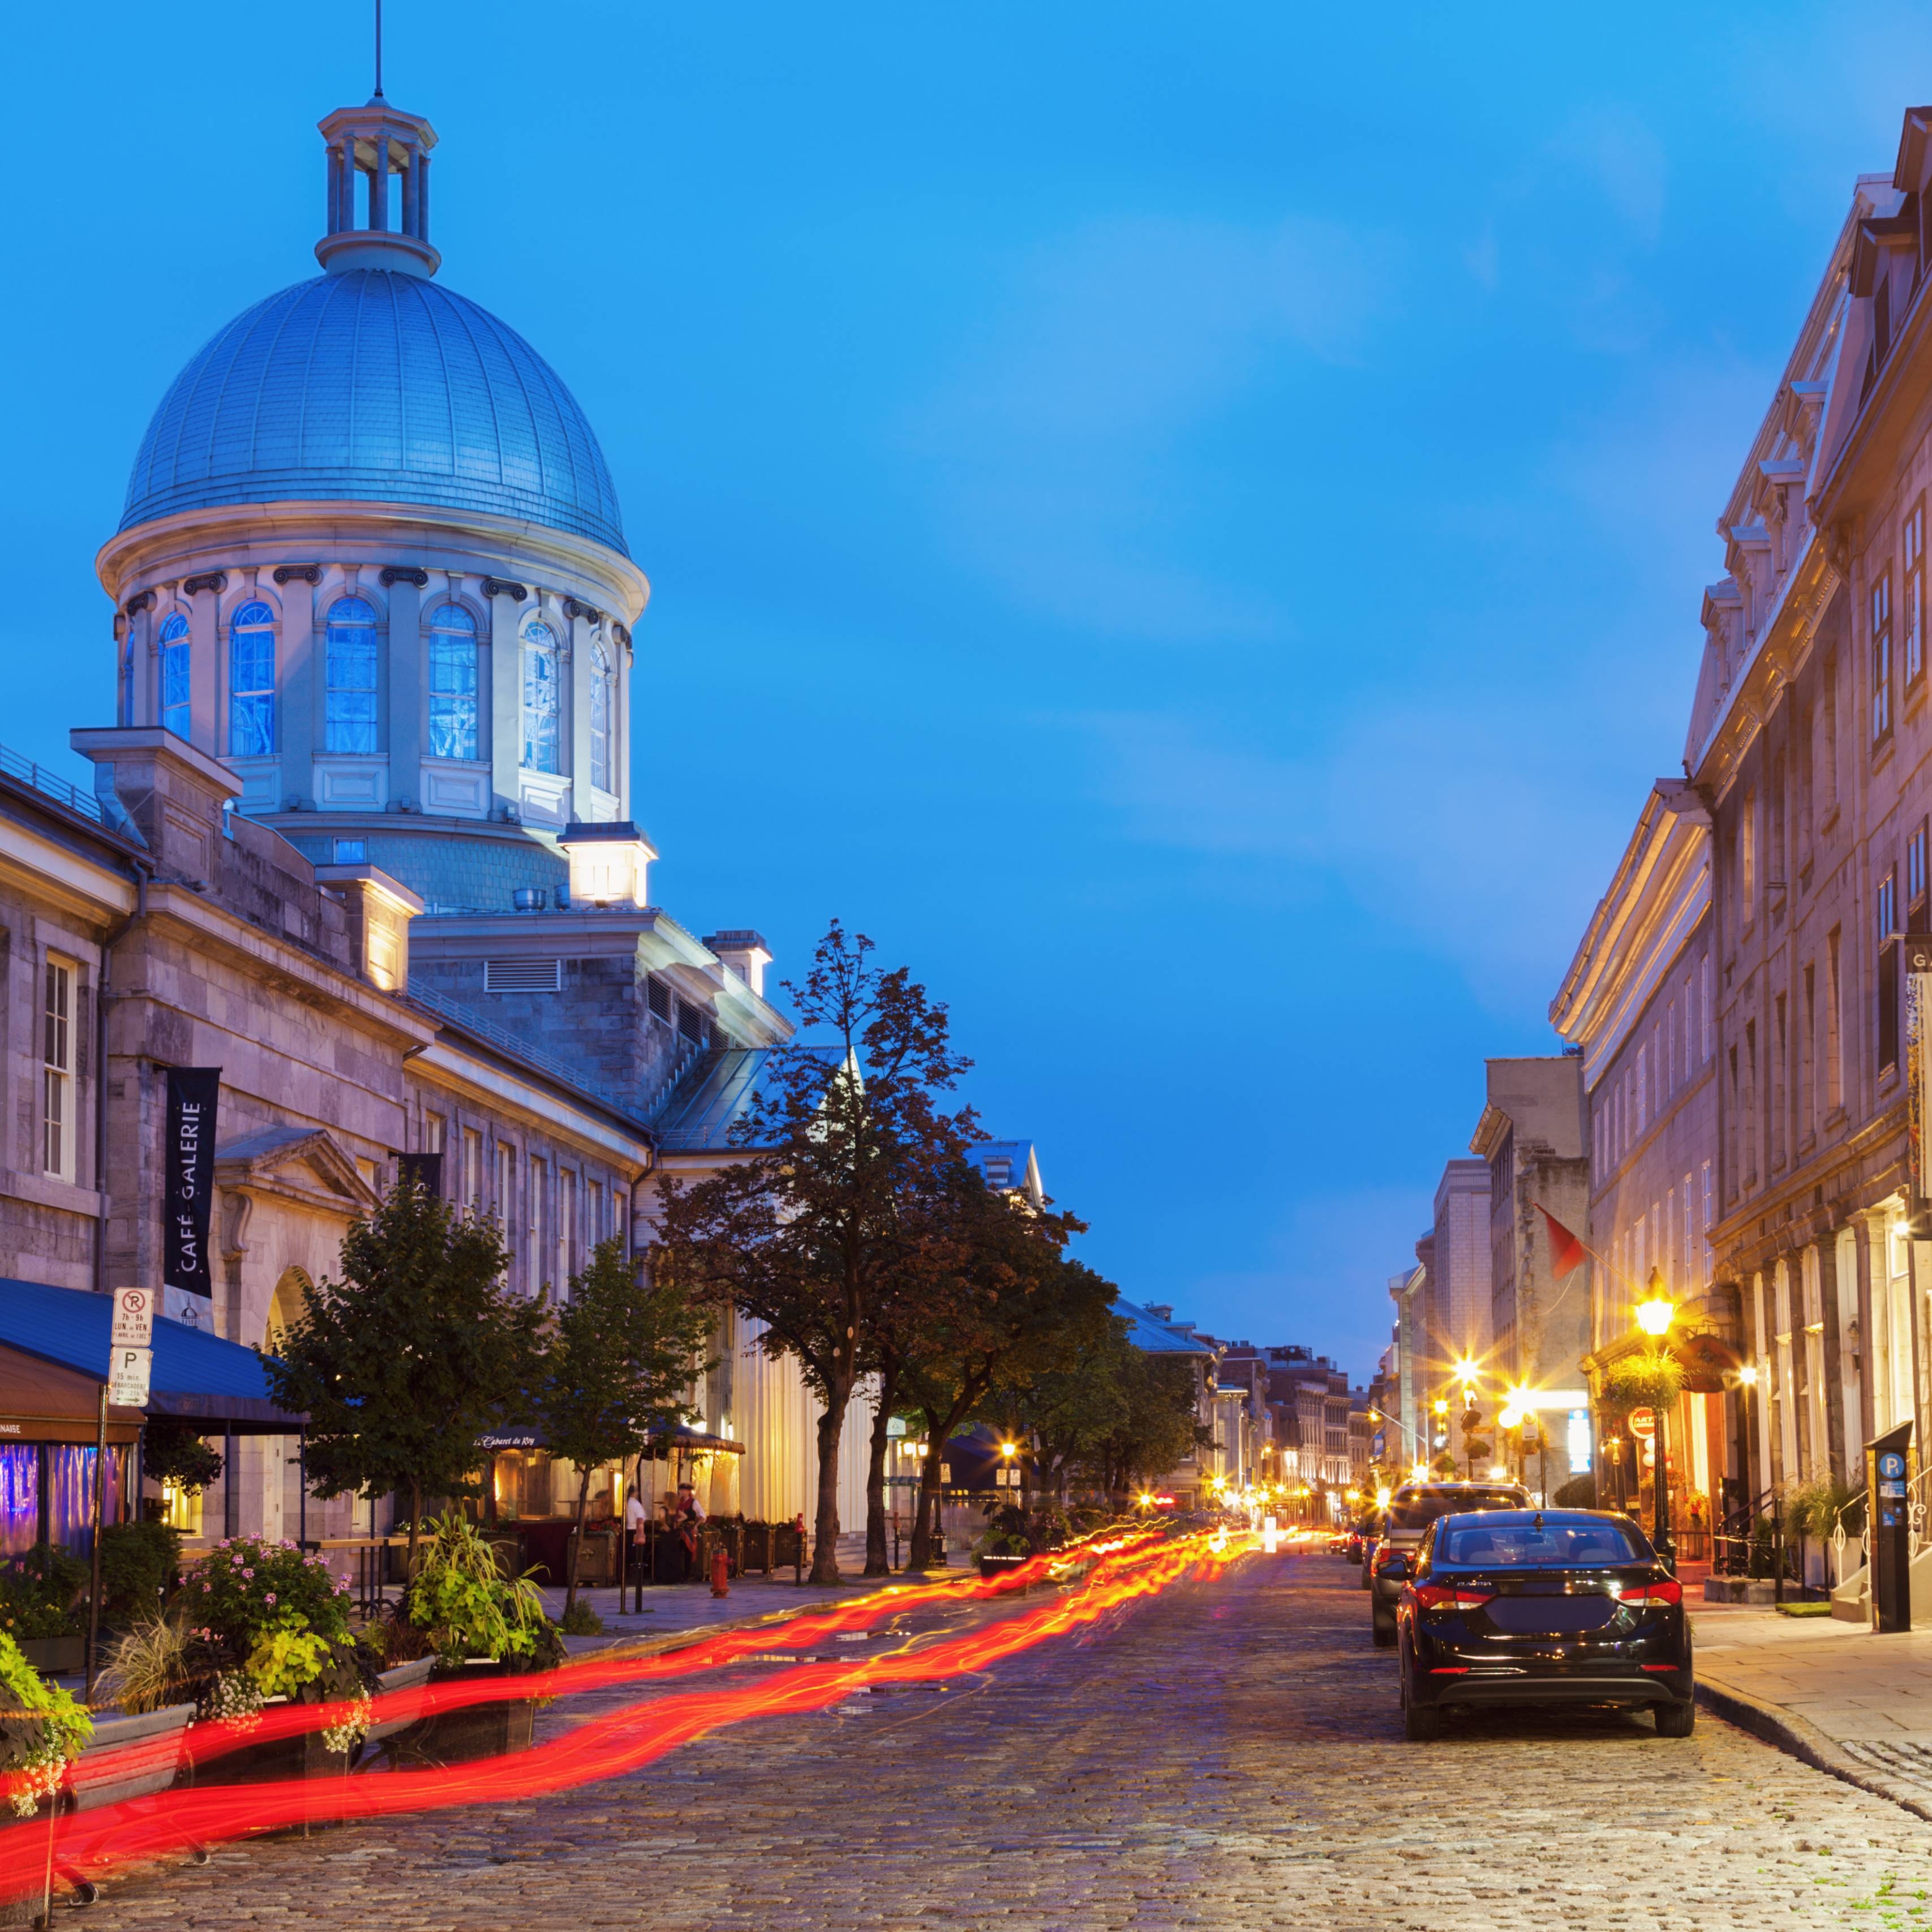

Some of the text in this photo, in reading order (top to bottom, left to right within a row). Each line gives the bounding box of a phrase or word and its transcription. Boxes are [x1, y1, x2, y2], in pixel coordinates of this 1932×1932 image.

[124, 1352, 137, 1368] P
[0, 1424, 20, 1434] NAISE
[482, 1435, 512, 1449] Cabaret
[513, 1436, 521, 1445] du
[521, 1436, 535, 1446] Roy
